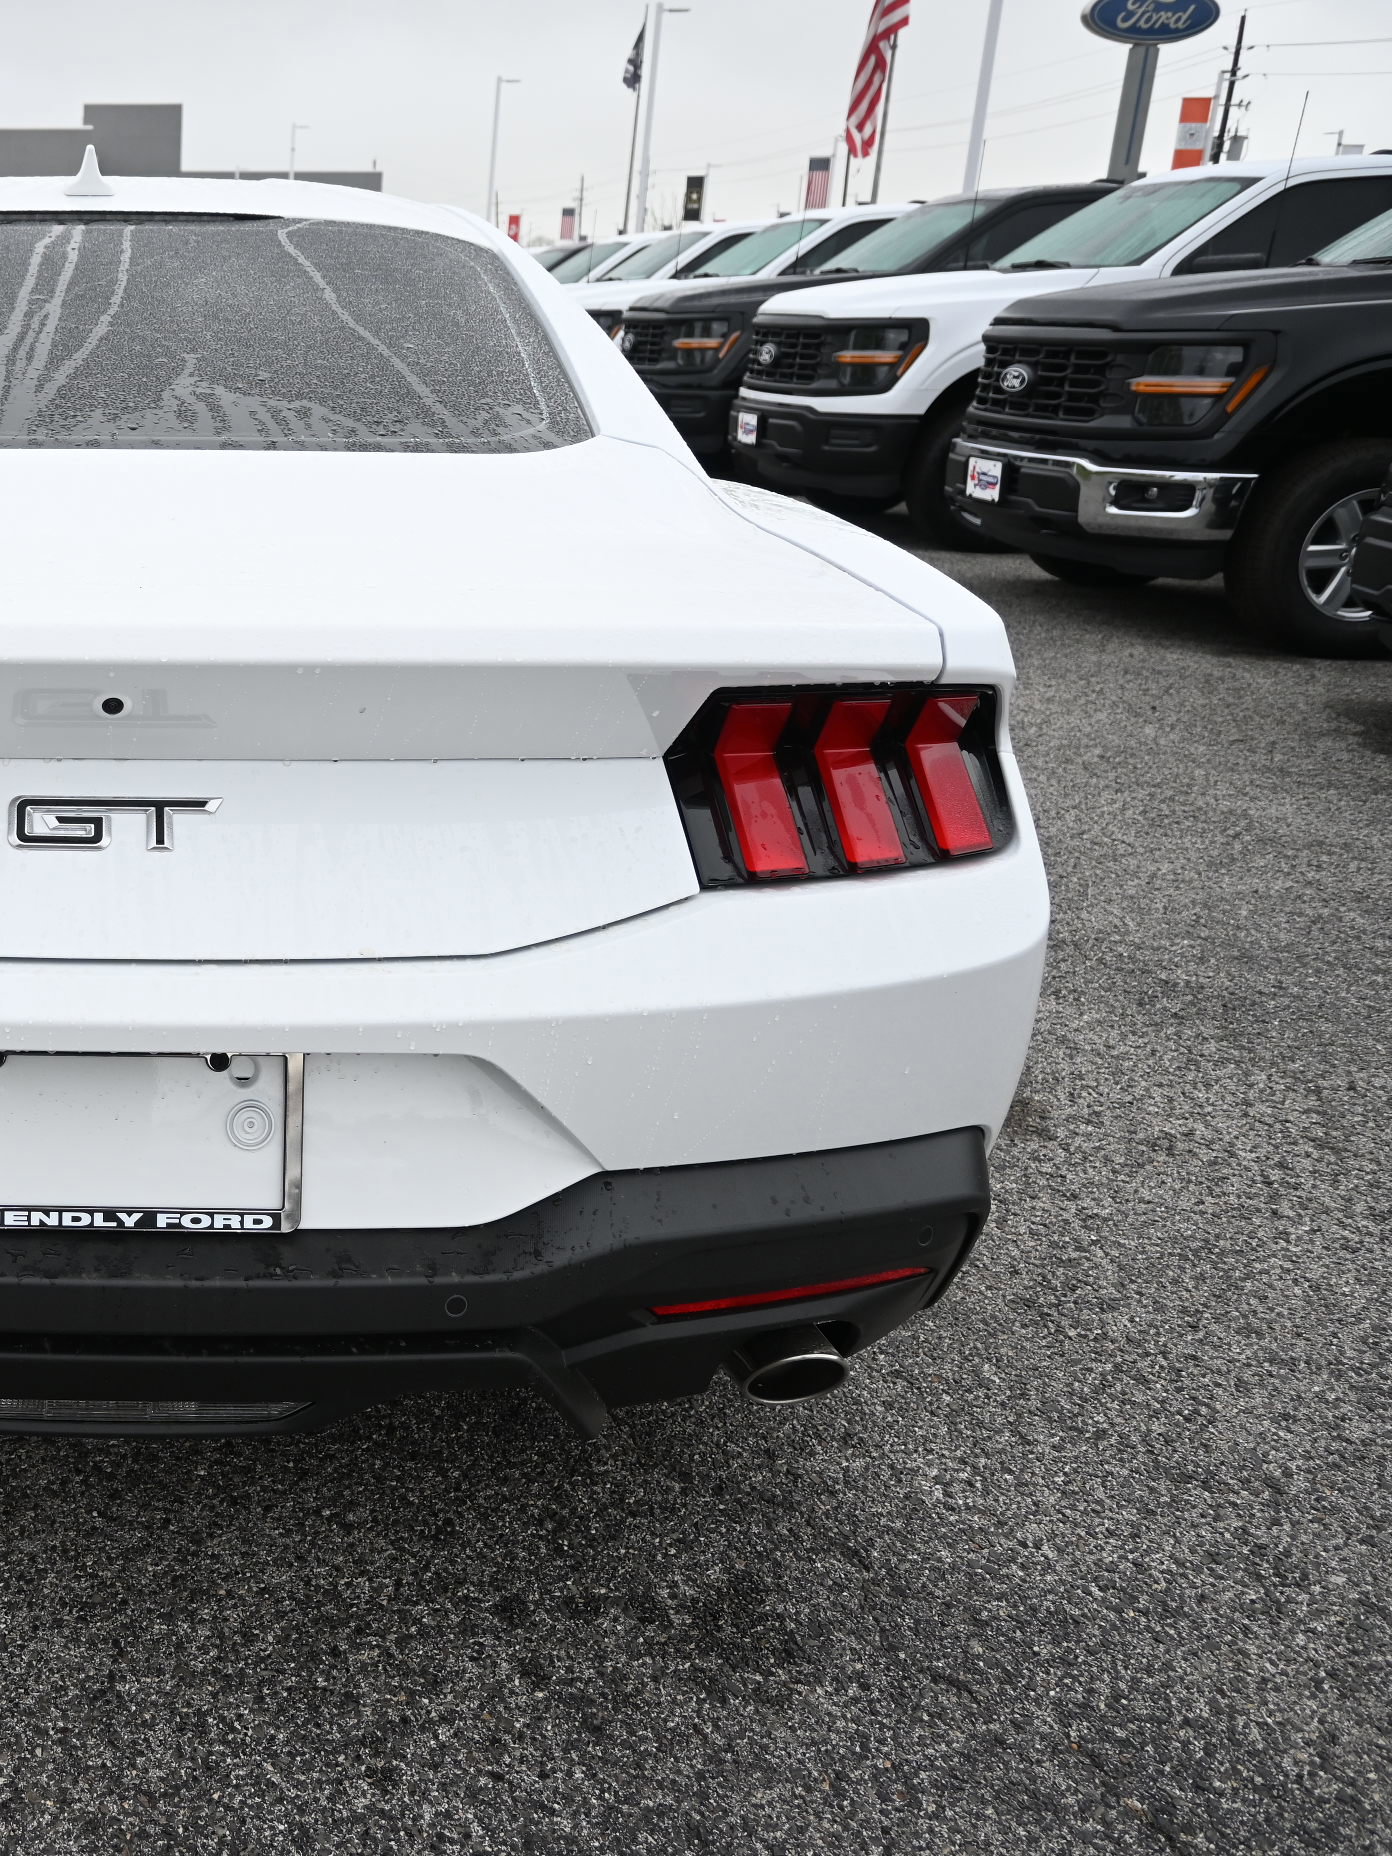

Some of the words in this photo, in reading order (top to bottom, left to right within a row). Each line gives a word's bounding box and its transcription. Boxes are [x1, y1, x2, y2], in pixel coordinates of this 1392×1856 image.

[1116, 0, 1195, 28] Ford
[8, 795, 224, 851] GT
[156, 1212, 274, 1230] FORD
